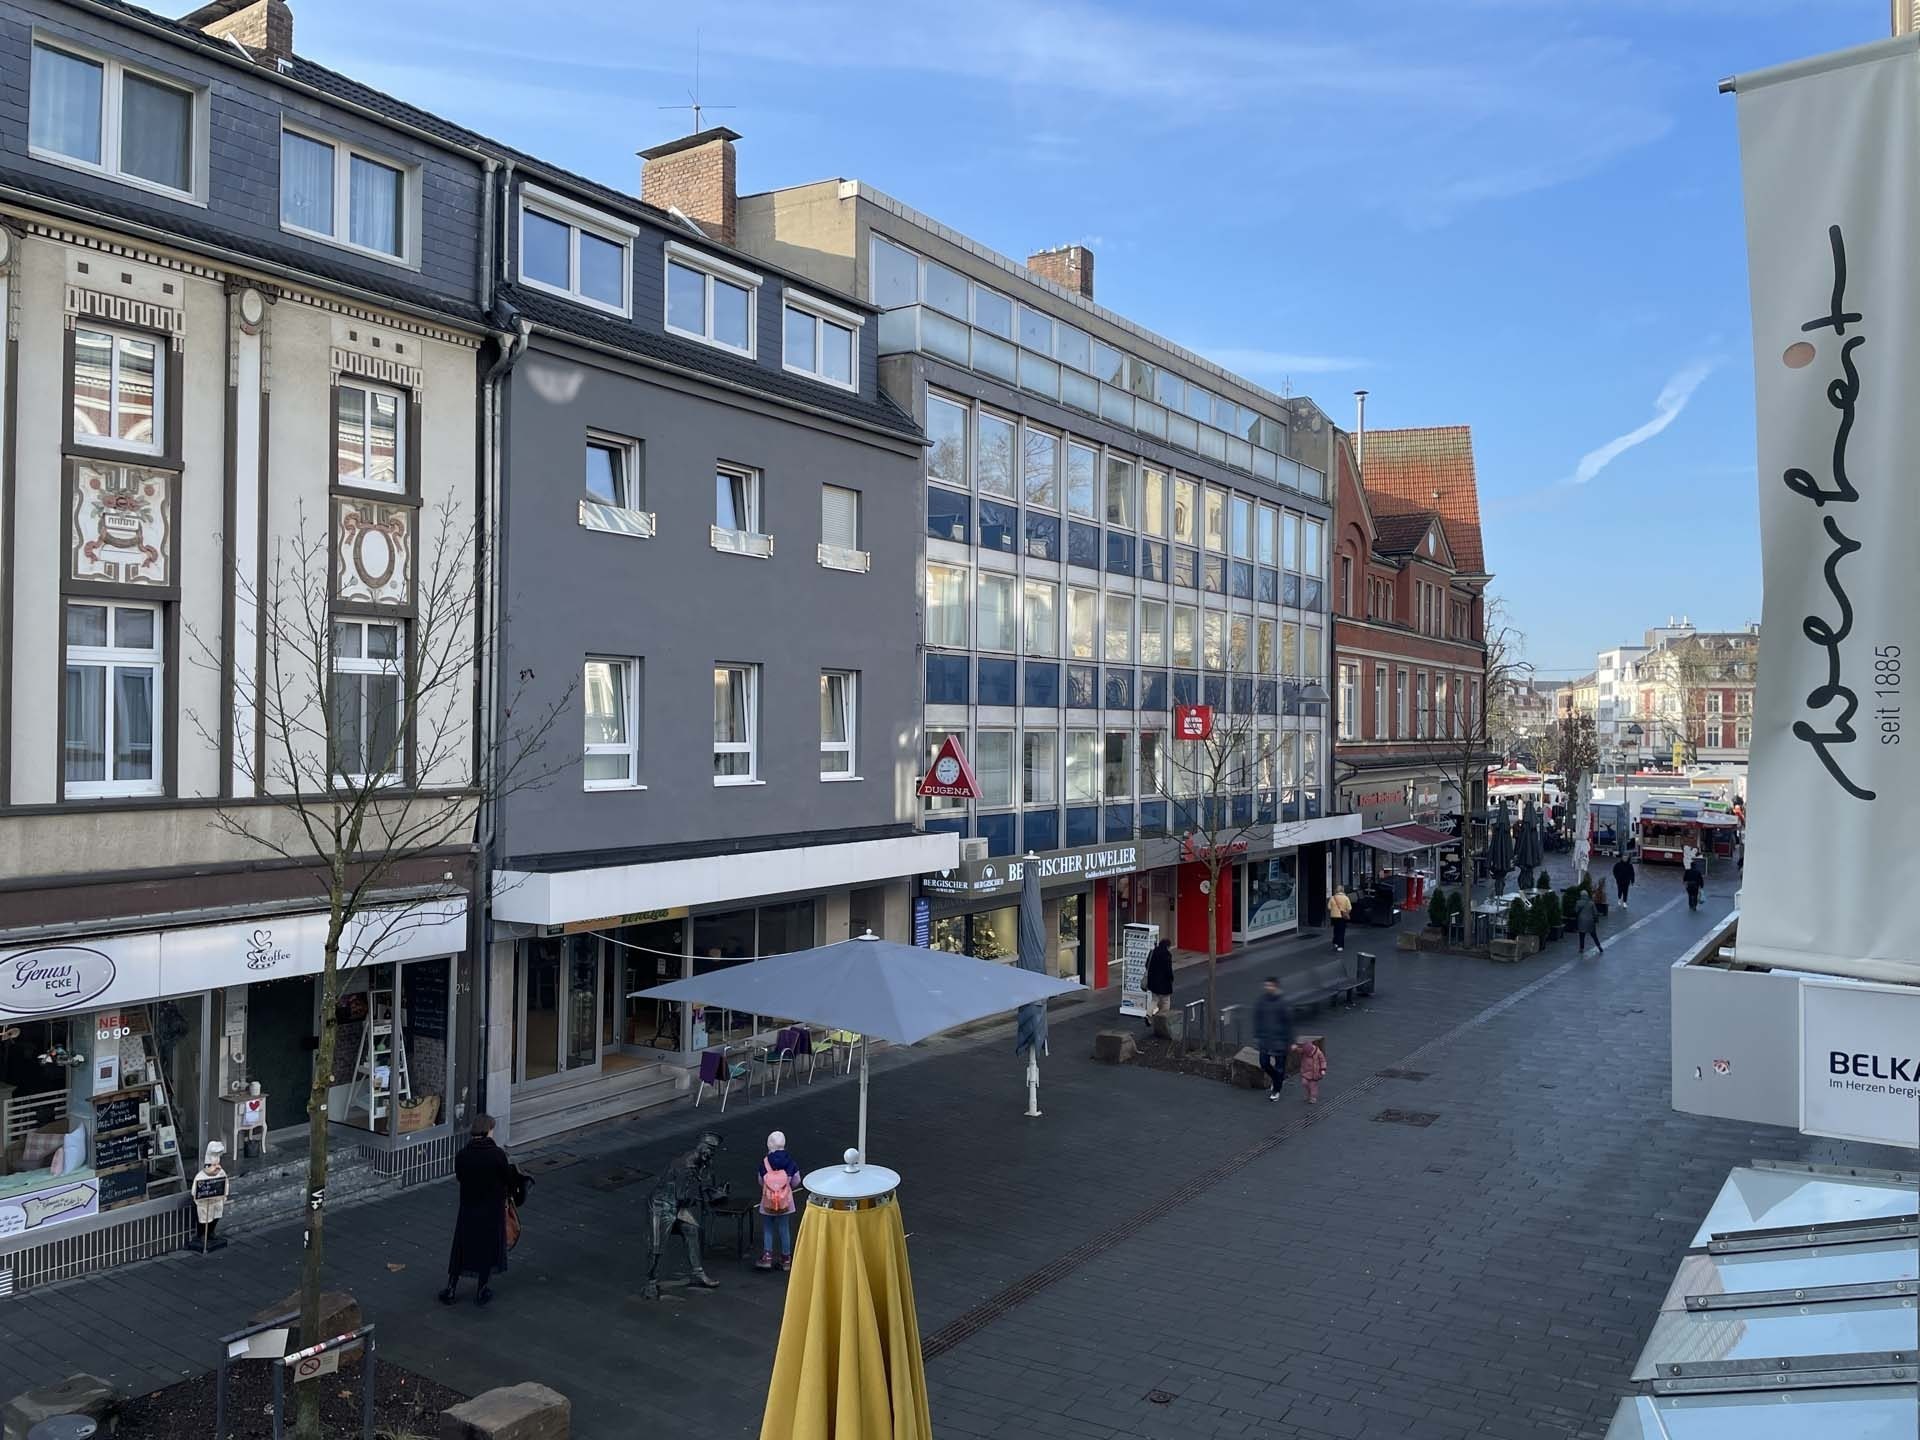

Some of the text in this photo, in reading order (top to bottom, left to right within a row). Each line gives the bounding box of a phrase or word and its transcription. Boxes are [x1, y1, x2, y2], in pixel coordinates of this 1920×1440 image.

[1874, 645, 1901, 745] seit 1885
[924, 785, 971, 796] DUGENA
[1085, 847, 1136, 871] JUWELIER
[923, 878, 969, 889] BERGISCHER
[973, 878, 1005, 889] BERGISCHER
[11, 959, 73, 990] Genuss
[45, 978, 72, 990] ECKE
[96, 1026, 131, 1040] to go
[1829, 1078, 1843, 1088] Im
[1845, 1080, 1886, 1093] Herzen
